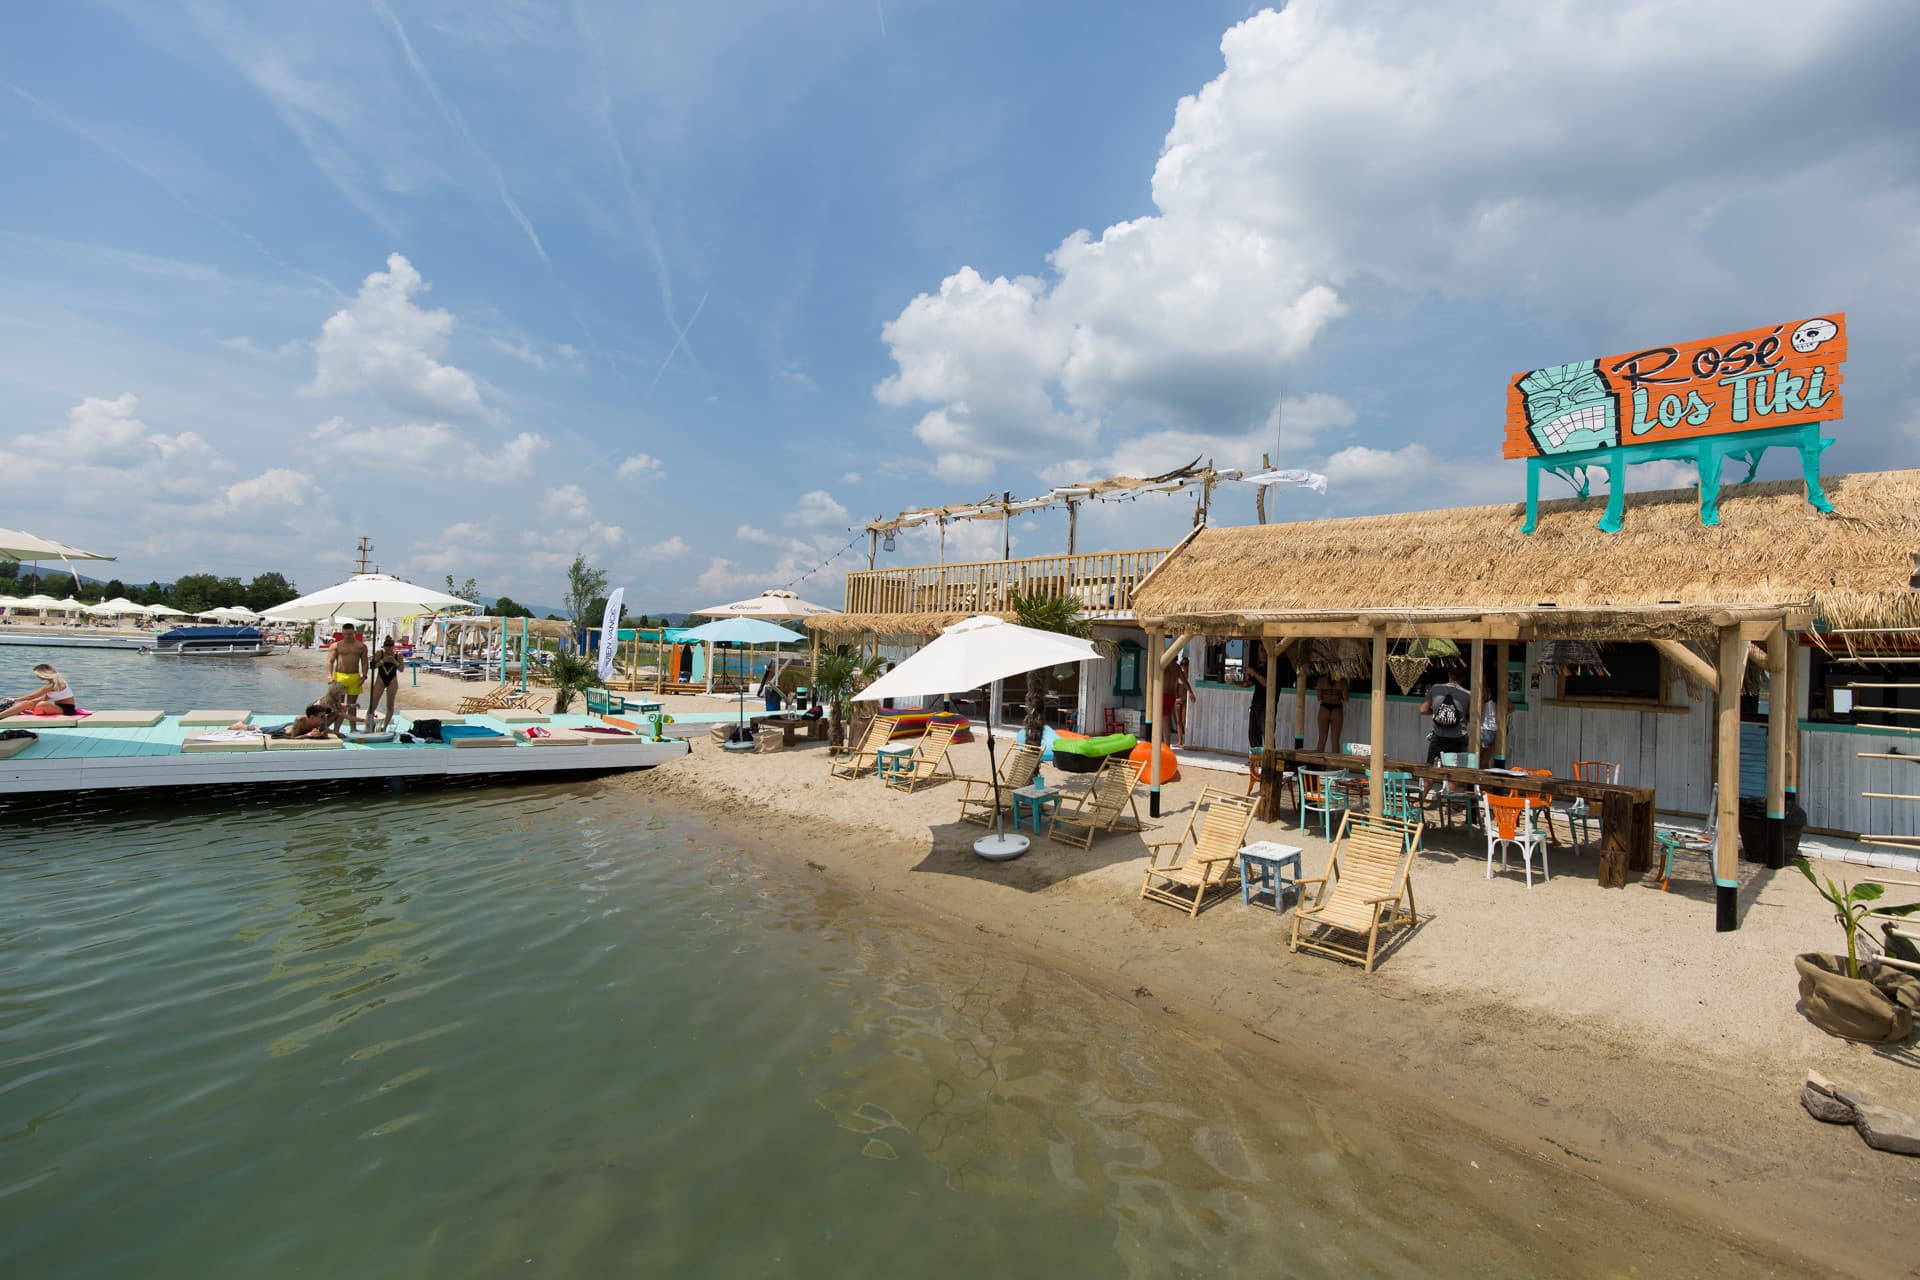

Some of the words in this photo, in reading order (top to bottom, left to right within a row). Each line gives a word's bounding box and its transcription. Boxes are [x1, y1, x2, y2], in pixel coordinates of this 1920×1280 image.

[1612, 325, 1786, 388] Rosé
[1631, 386, 1715, 436] Los
[1718, 366, 1835, 423] Tiki
